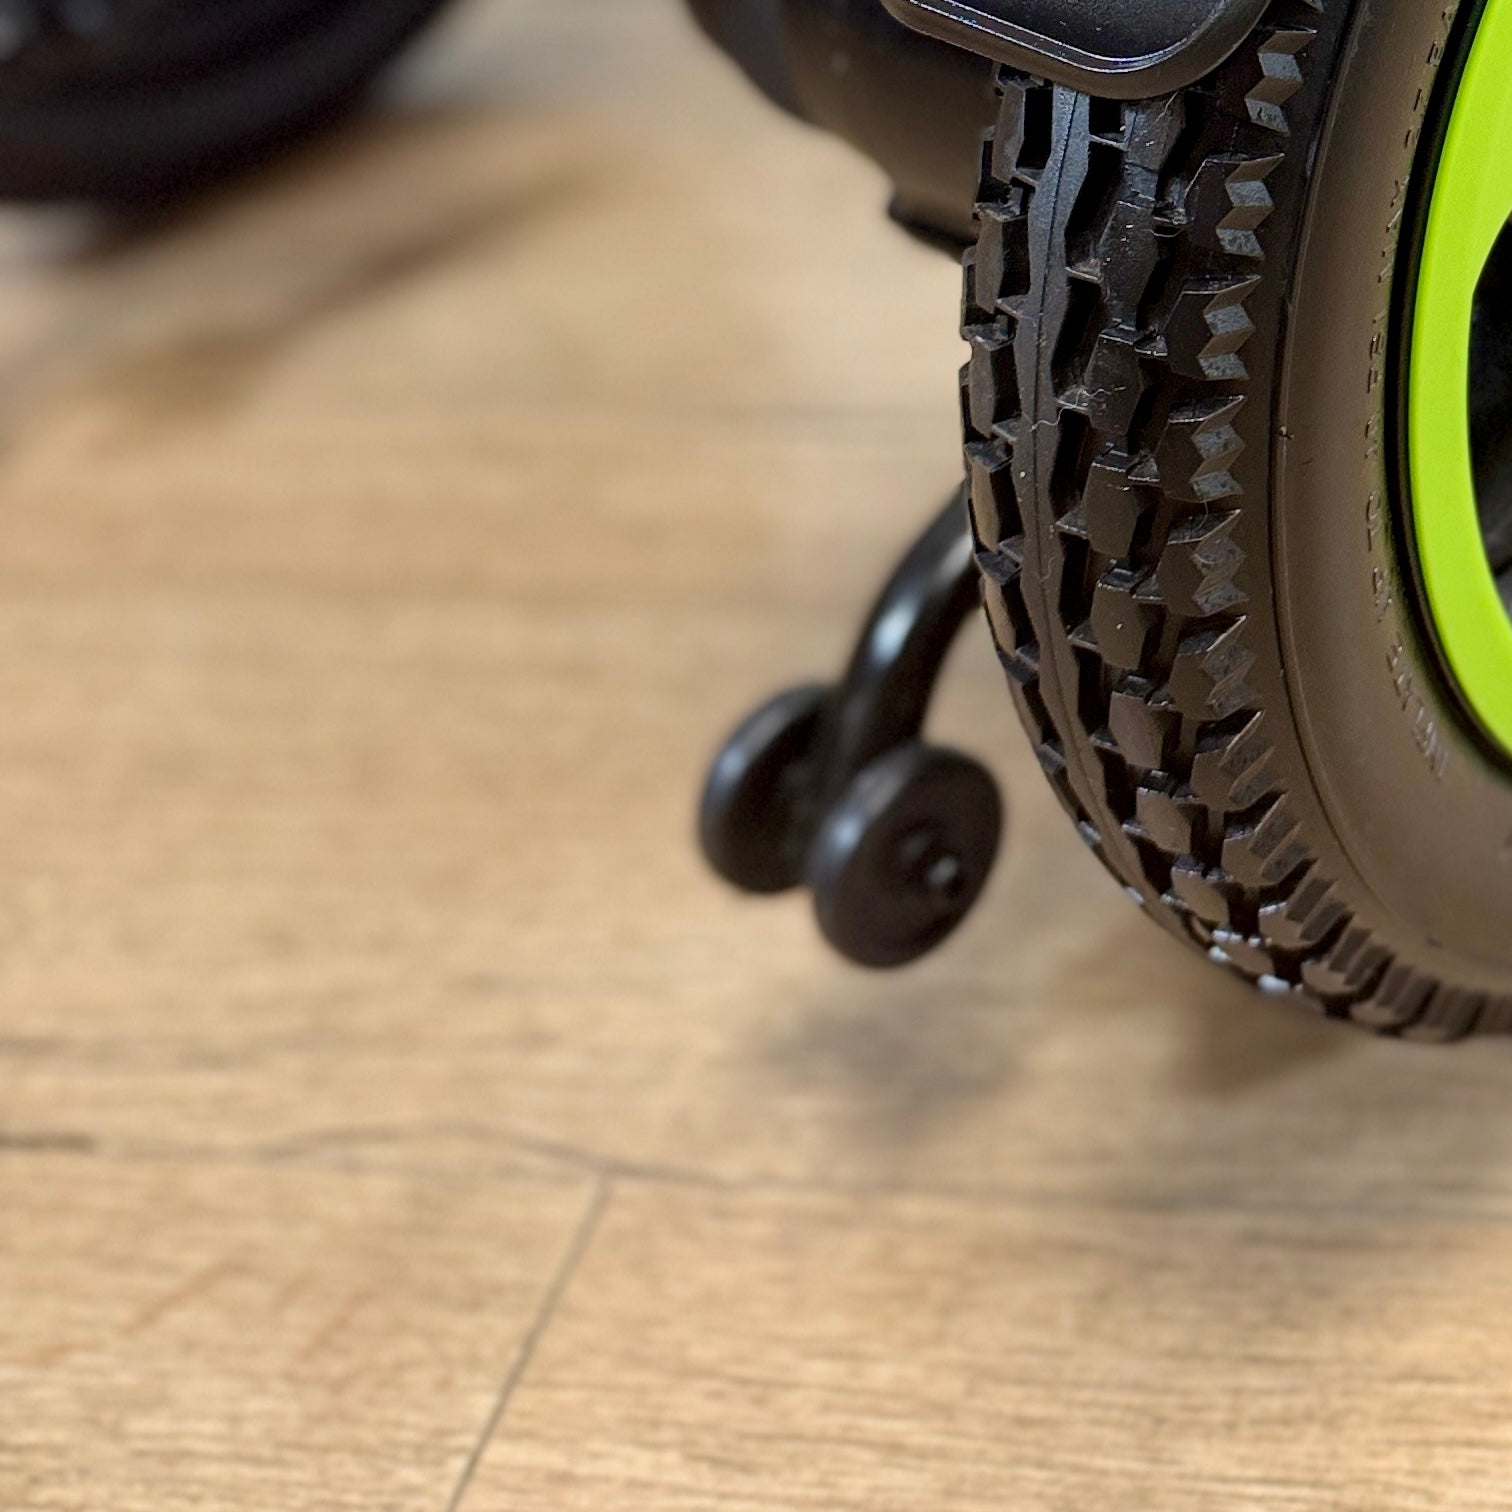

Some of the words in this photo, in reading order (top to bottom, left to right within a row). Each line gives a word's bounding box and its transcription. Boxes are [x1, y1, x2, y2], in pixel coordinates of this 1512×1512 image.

[1376, 173, 1411, 285] MAX
[1366, 306, 1388, 395] PSI
[1365, 489, 1388, 553] TO
[1385, 630, 1449, 783] INFLATE
